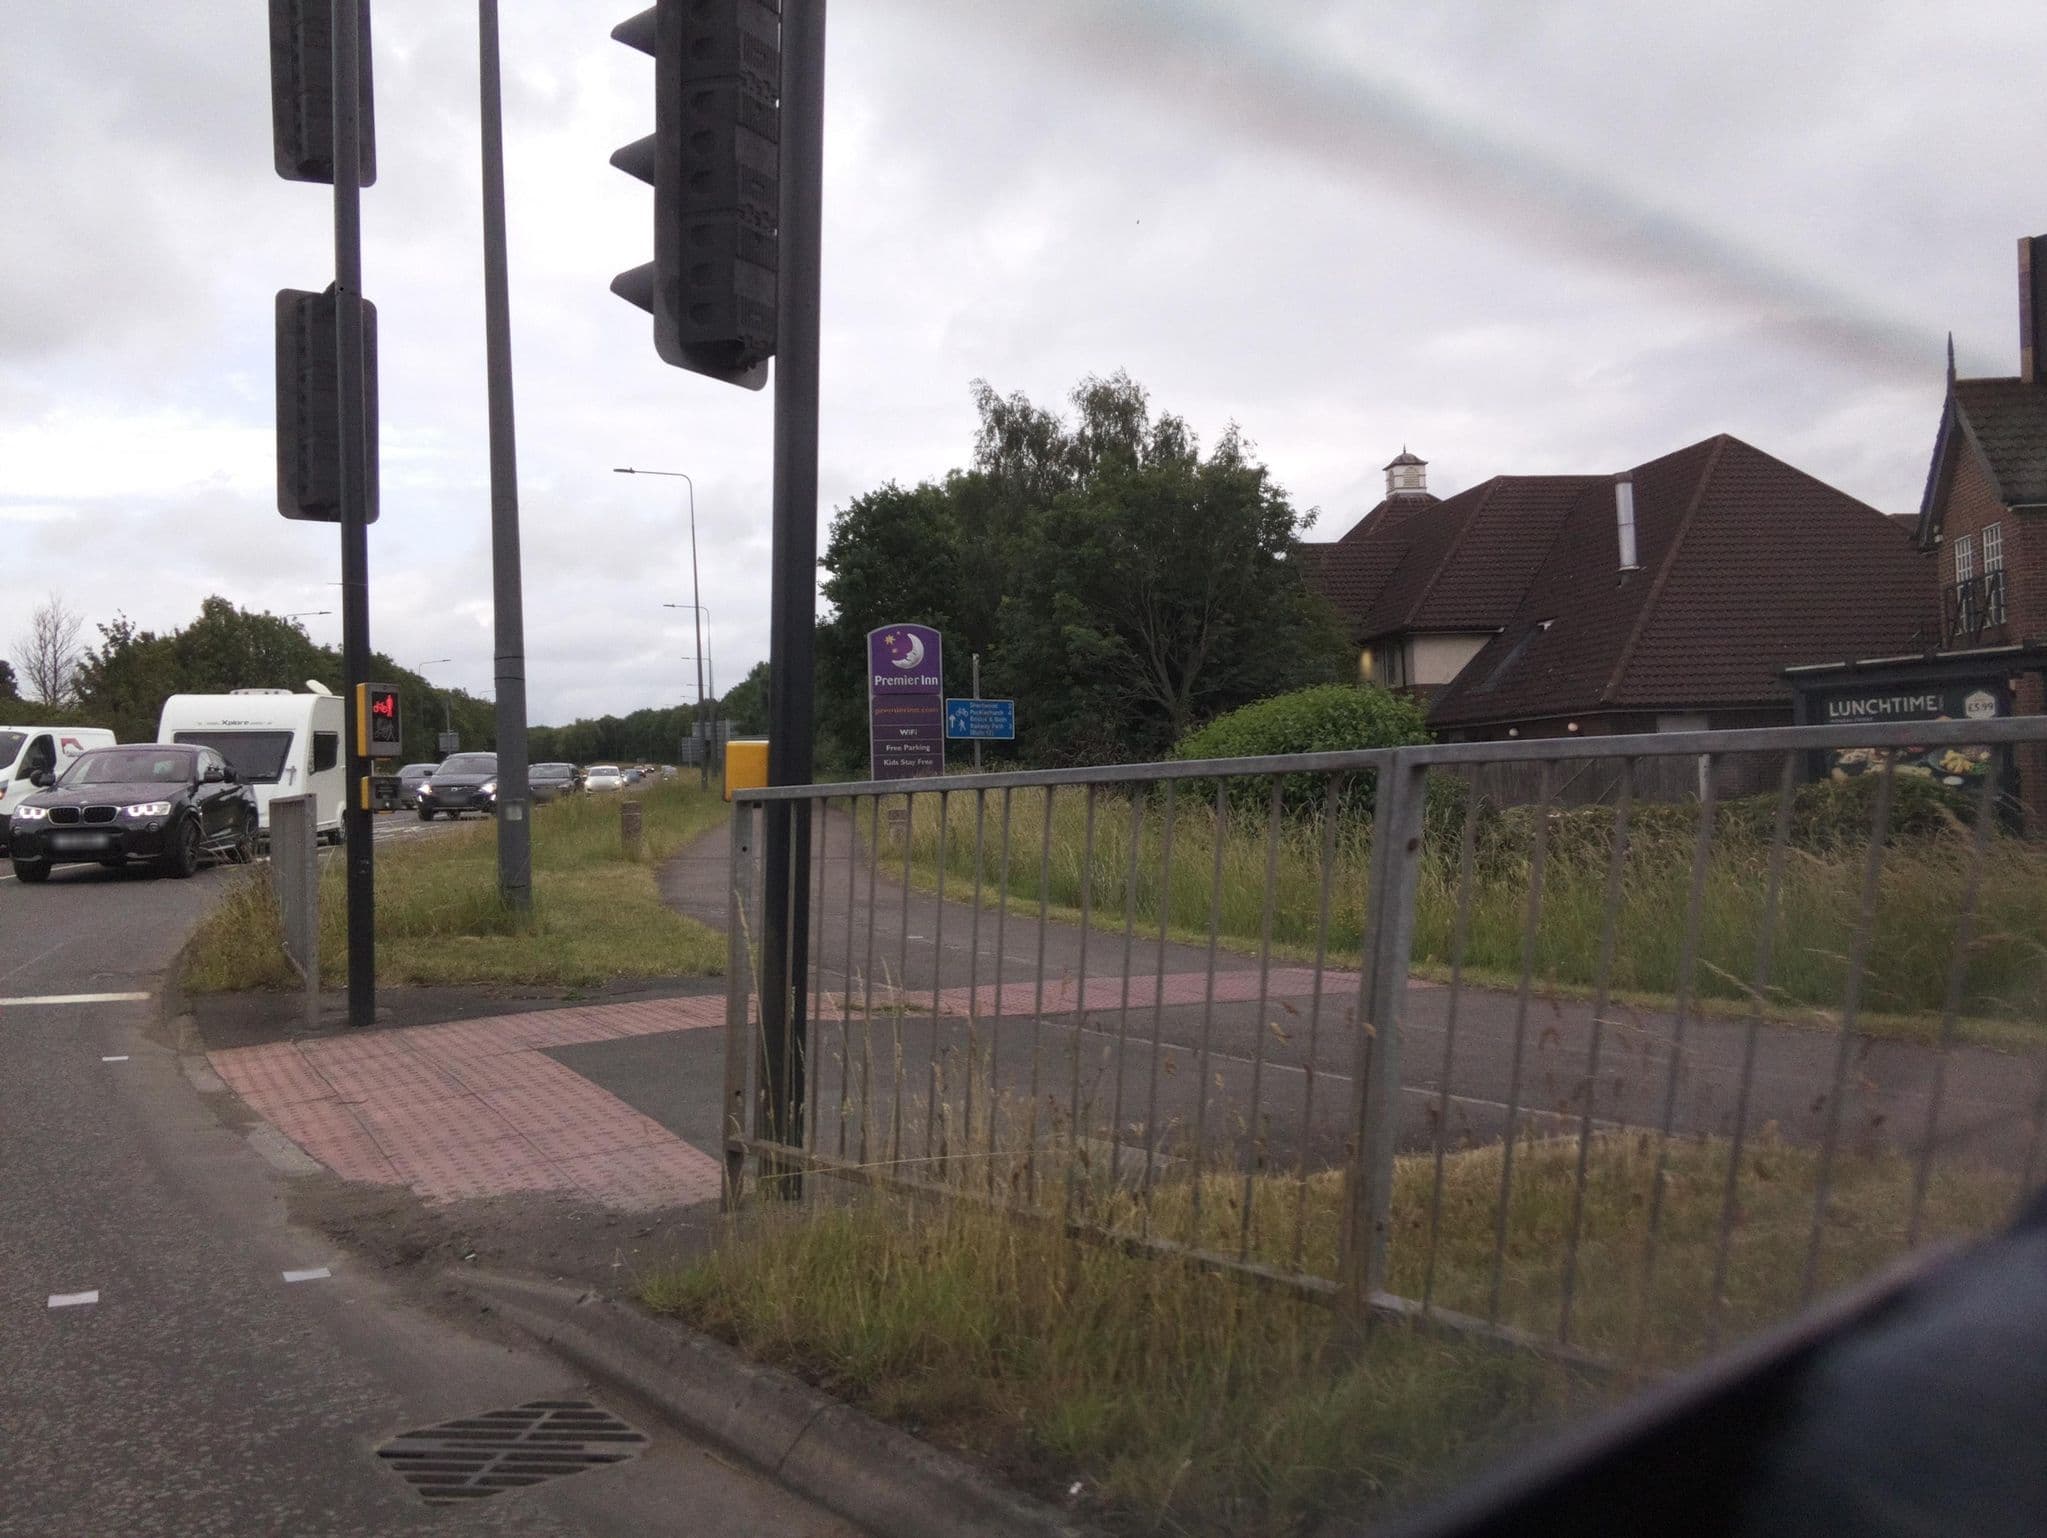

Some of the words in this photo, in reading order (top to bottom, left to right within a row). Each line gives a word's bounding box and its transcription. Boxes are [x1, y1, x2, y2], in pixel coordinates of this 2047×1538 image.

[875, 675, 919, 686] Premier
[921, 675, 939, 686] Inn
[1828, 695, 1938, 717] LUNCHTIME
[899, 728, 918, 736] WiFi
[886, 744, 902, 752] Free
[904, 744, 931, 753] Parking
[883, 758, 899, 766] Kids
[900, 758, 916, 767] Stay
[917, 758, 933, 766] Free
